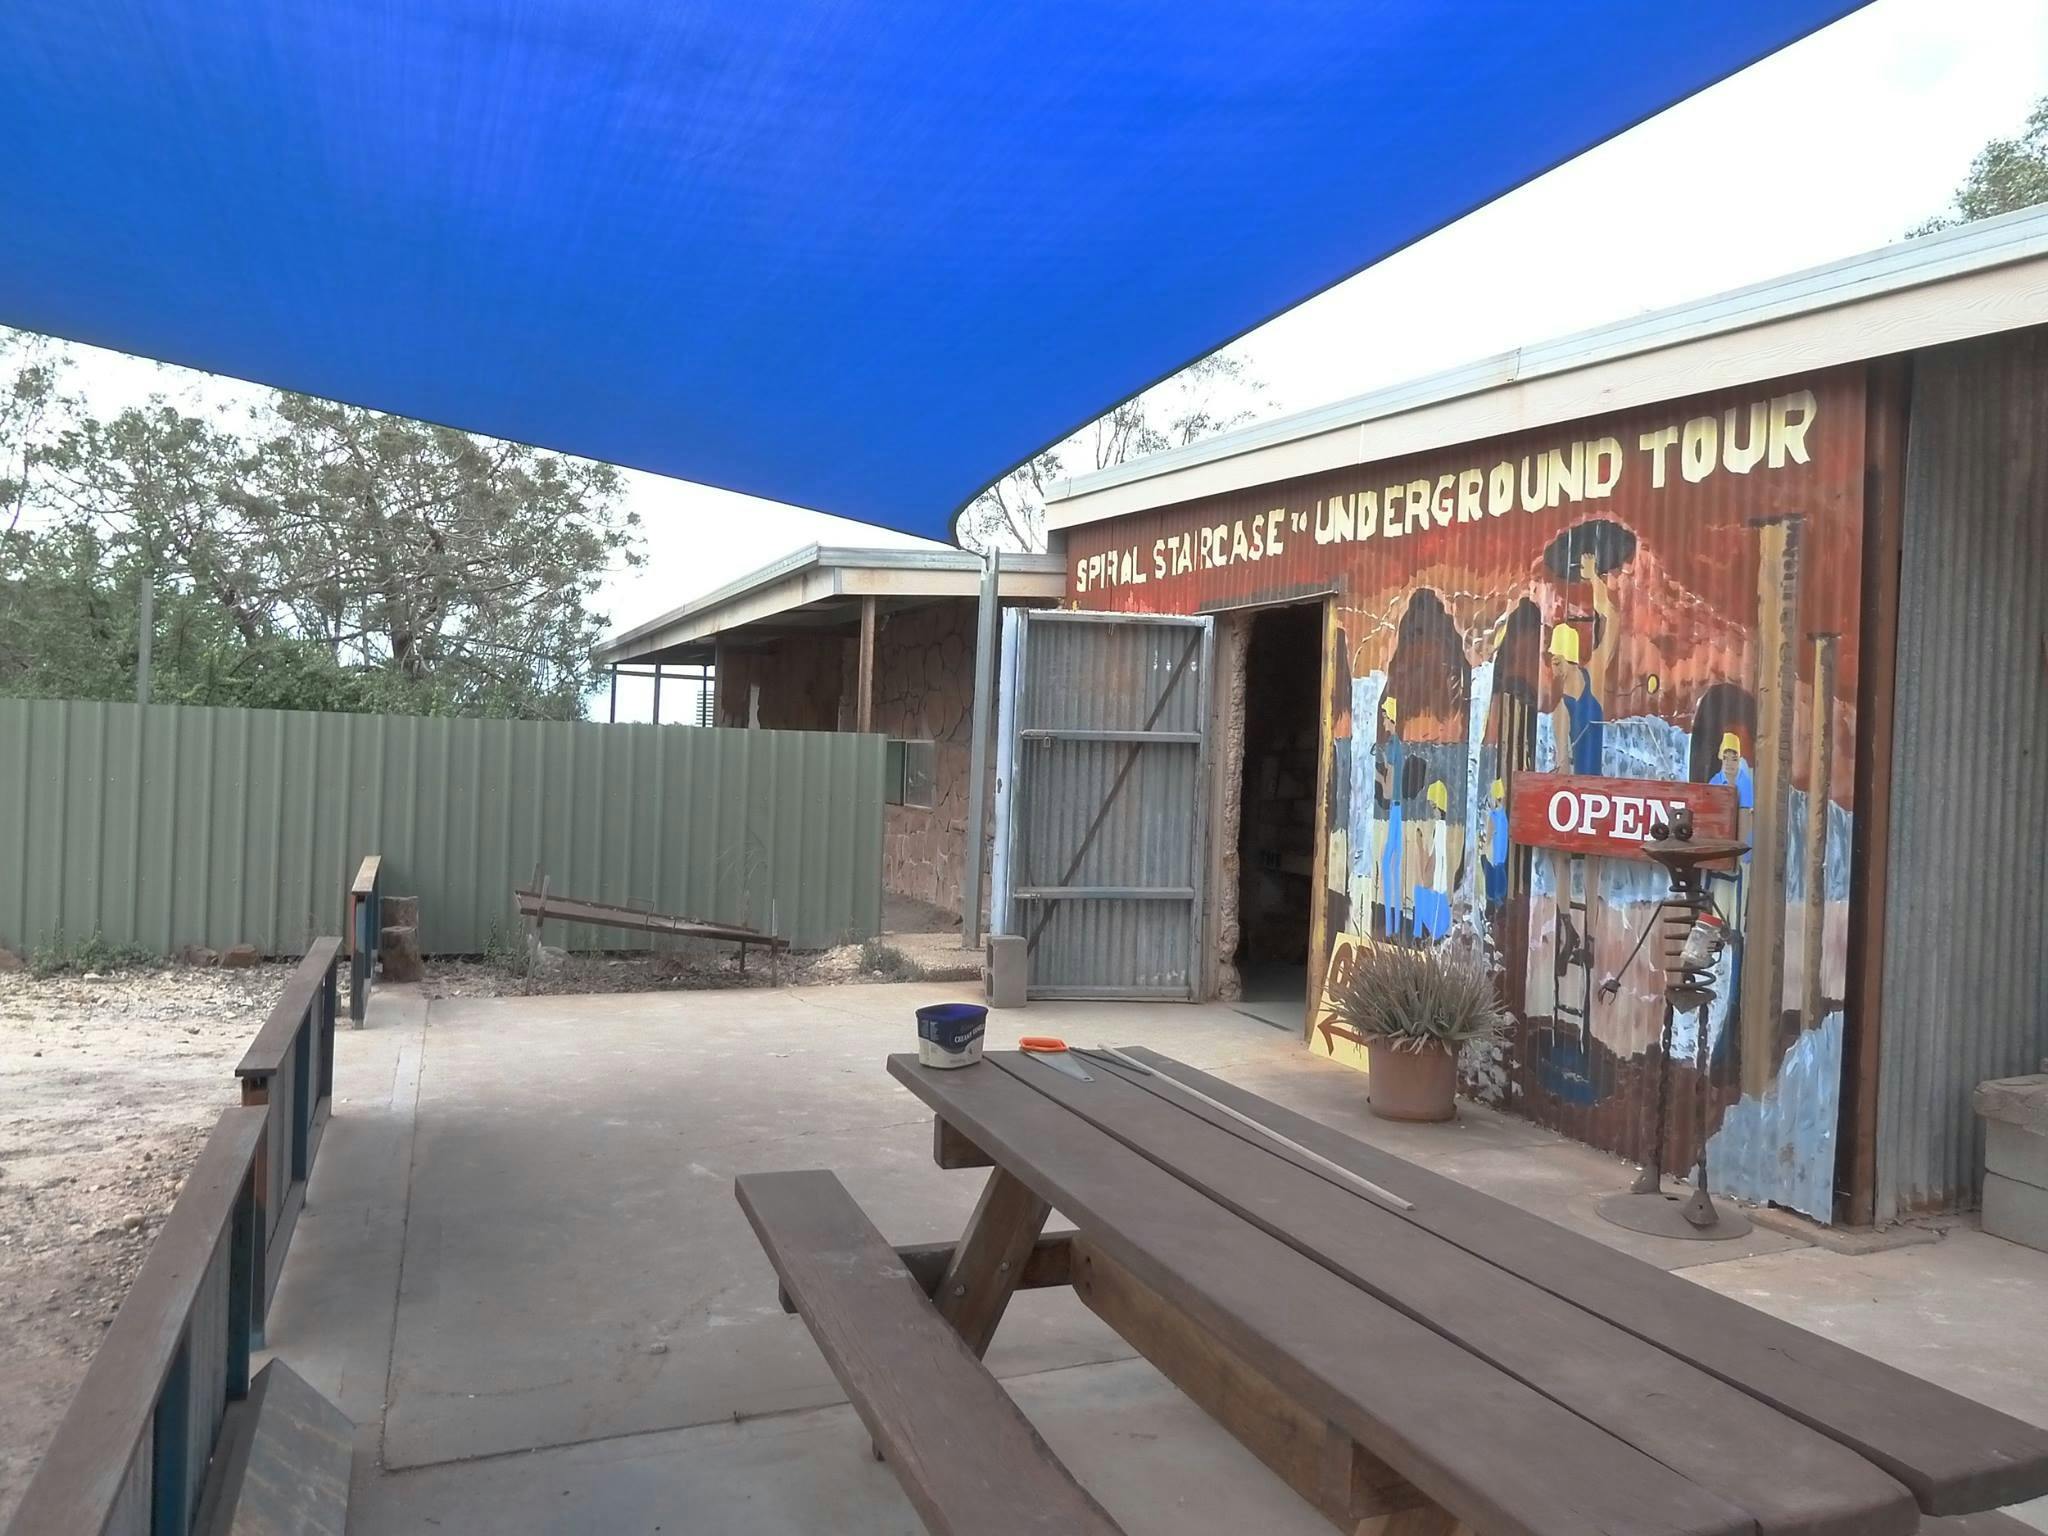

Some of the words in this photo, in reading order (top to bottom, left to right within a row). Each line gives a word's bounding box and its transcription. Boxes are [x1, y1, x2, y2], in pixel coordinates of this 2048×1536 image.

[1076, 546, 1146, 592] SPIRAL
[1153, 508, 1285, 580] STAIRCASE
[1315, 437, 1623, 545] UNDERGROUND
[1640, 389, 1817, 489] TOUR
